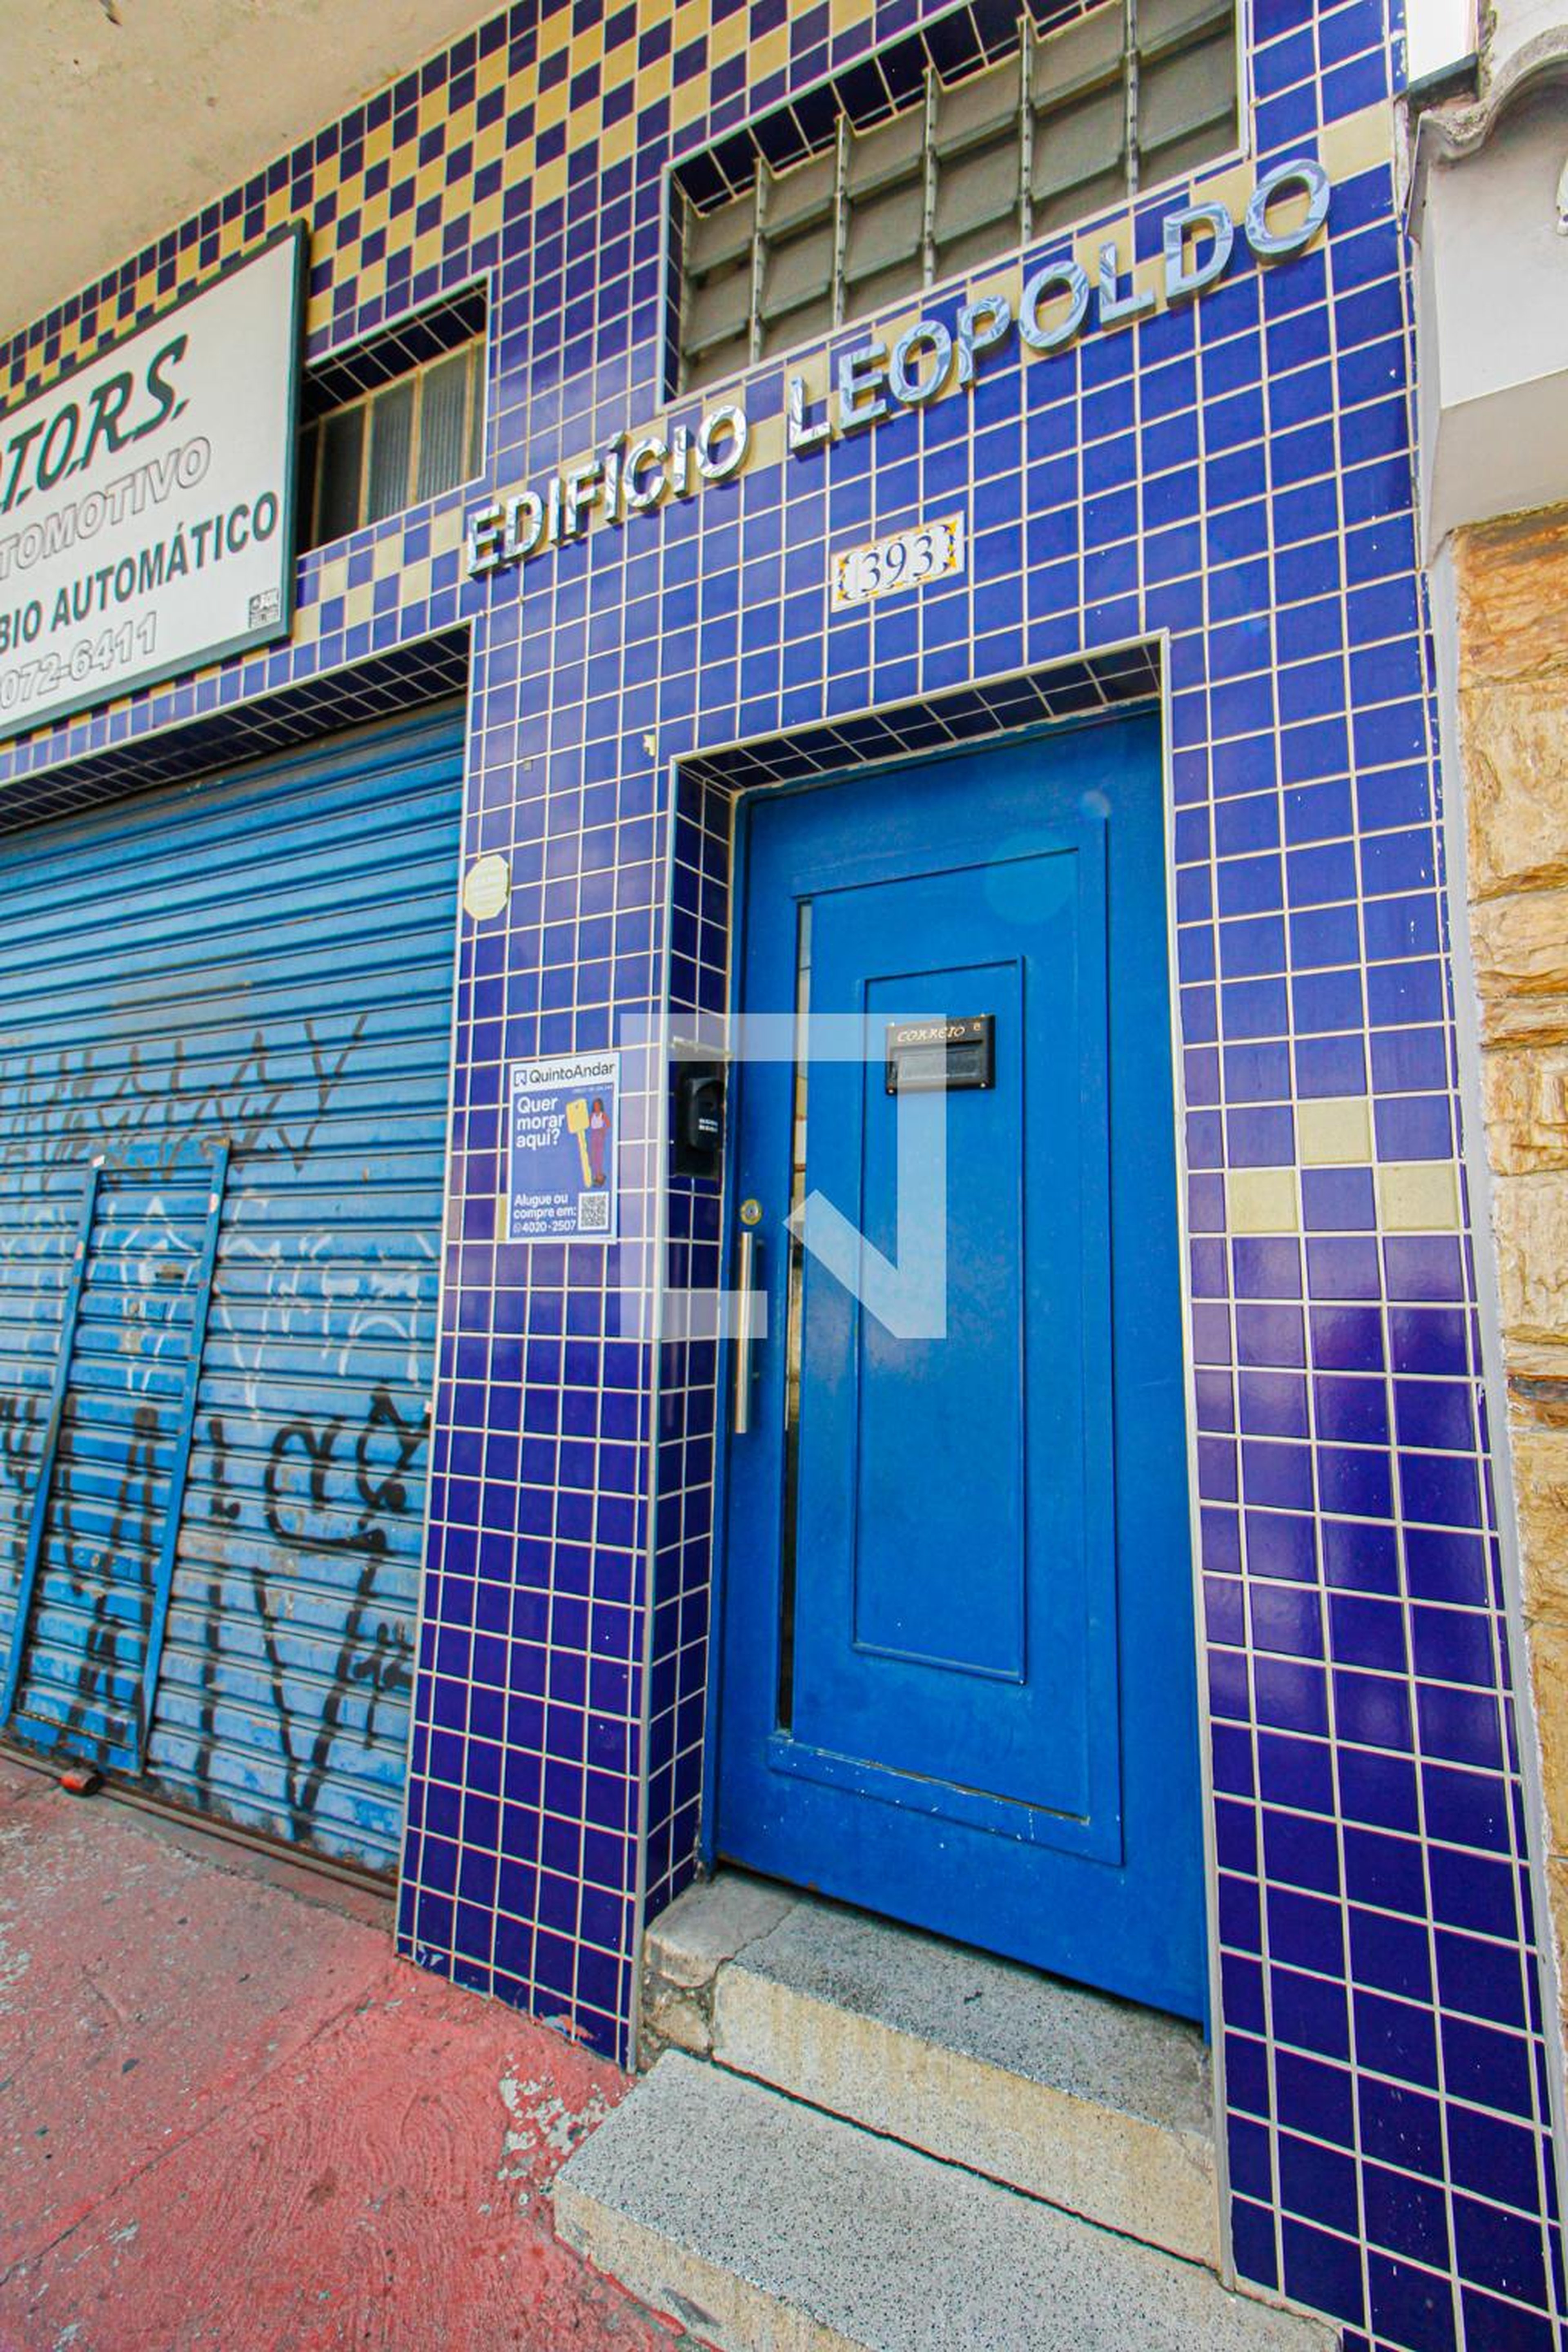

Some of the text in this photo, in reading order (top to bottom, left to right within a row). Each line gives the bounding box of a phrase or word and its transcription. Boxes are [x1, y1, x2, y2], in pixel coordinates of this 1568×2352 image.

[468, 159, 1331, 575] EDIFÍCIO LEOPOLDO
[50, 491, 278, 632] AUTOMÁTICO
[861, 535, 933, 591] 393
[898, 1026, 965, 1042] CORREIO
[530, 1062, 615, 1083] QuintoAndar
[517, 1096, 558, 1114] Quer
[517, 1114, 565, 1131] morar
[516, 1128, 561, 1151] aqui?
[514, 1193, 569, 1208] Alugue ou
[513, 1206, 577, 1220] compre em:
